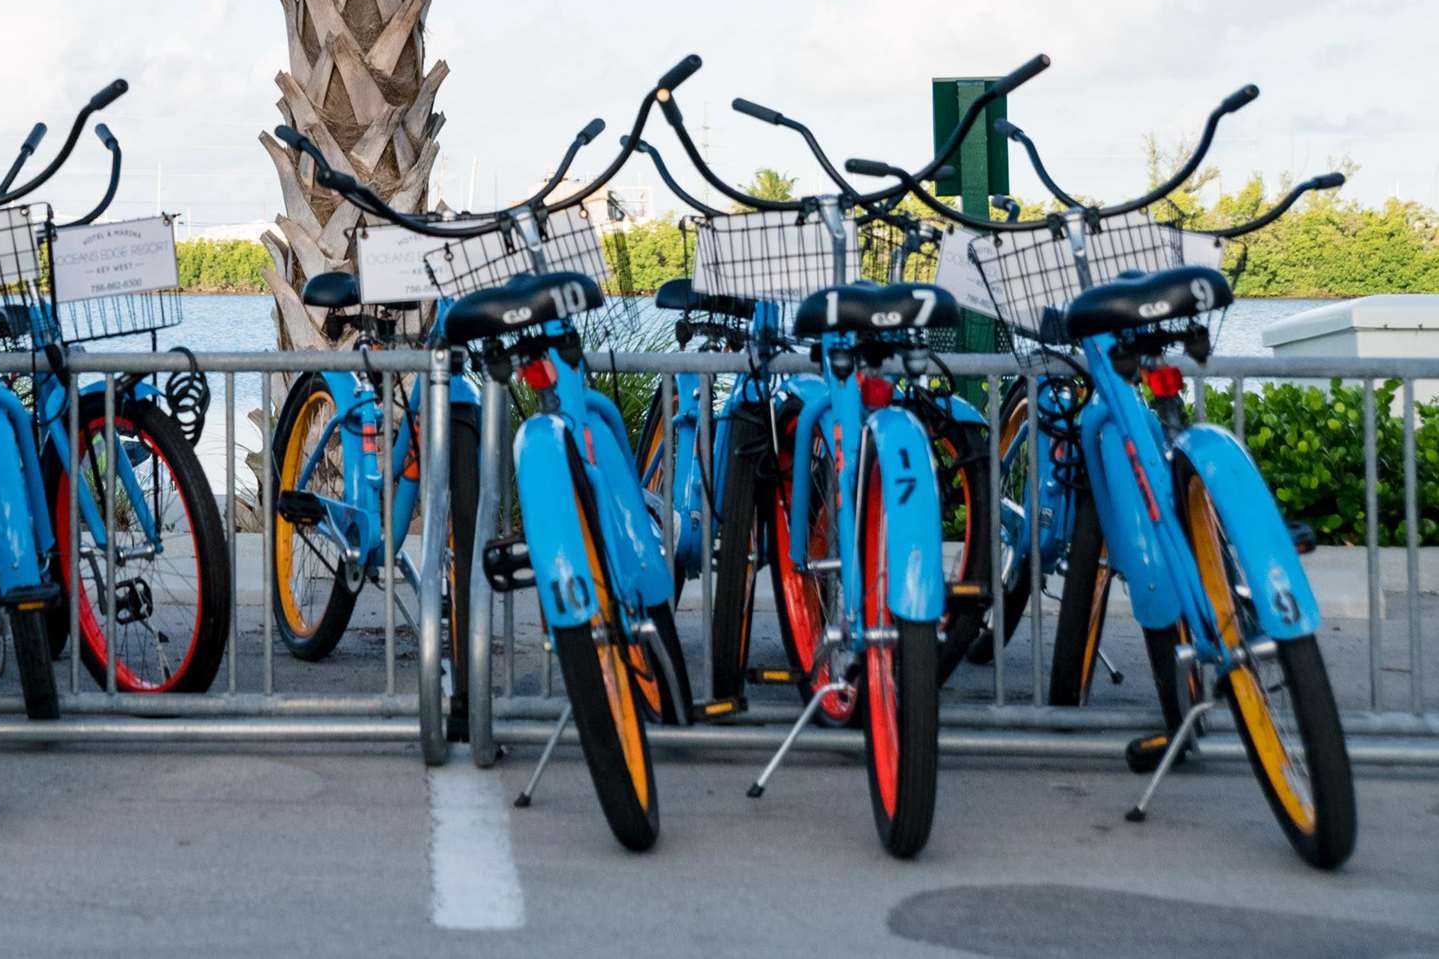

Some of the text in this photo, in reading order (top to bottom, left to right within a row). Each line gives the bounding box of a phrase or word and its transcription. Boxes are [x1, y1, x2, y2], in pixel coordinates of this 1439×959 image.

[96, 263, 133, 274] KEY WEST
[550, 280, 587, 319] 10
[1190, 277, 1215, 311] 9
[550, 576, 590, 614] 10
[1273, 590, 1300, 625] 9
